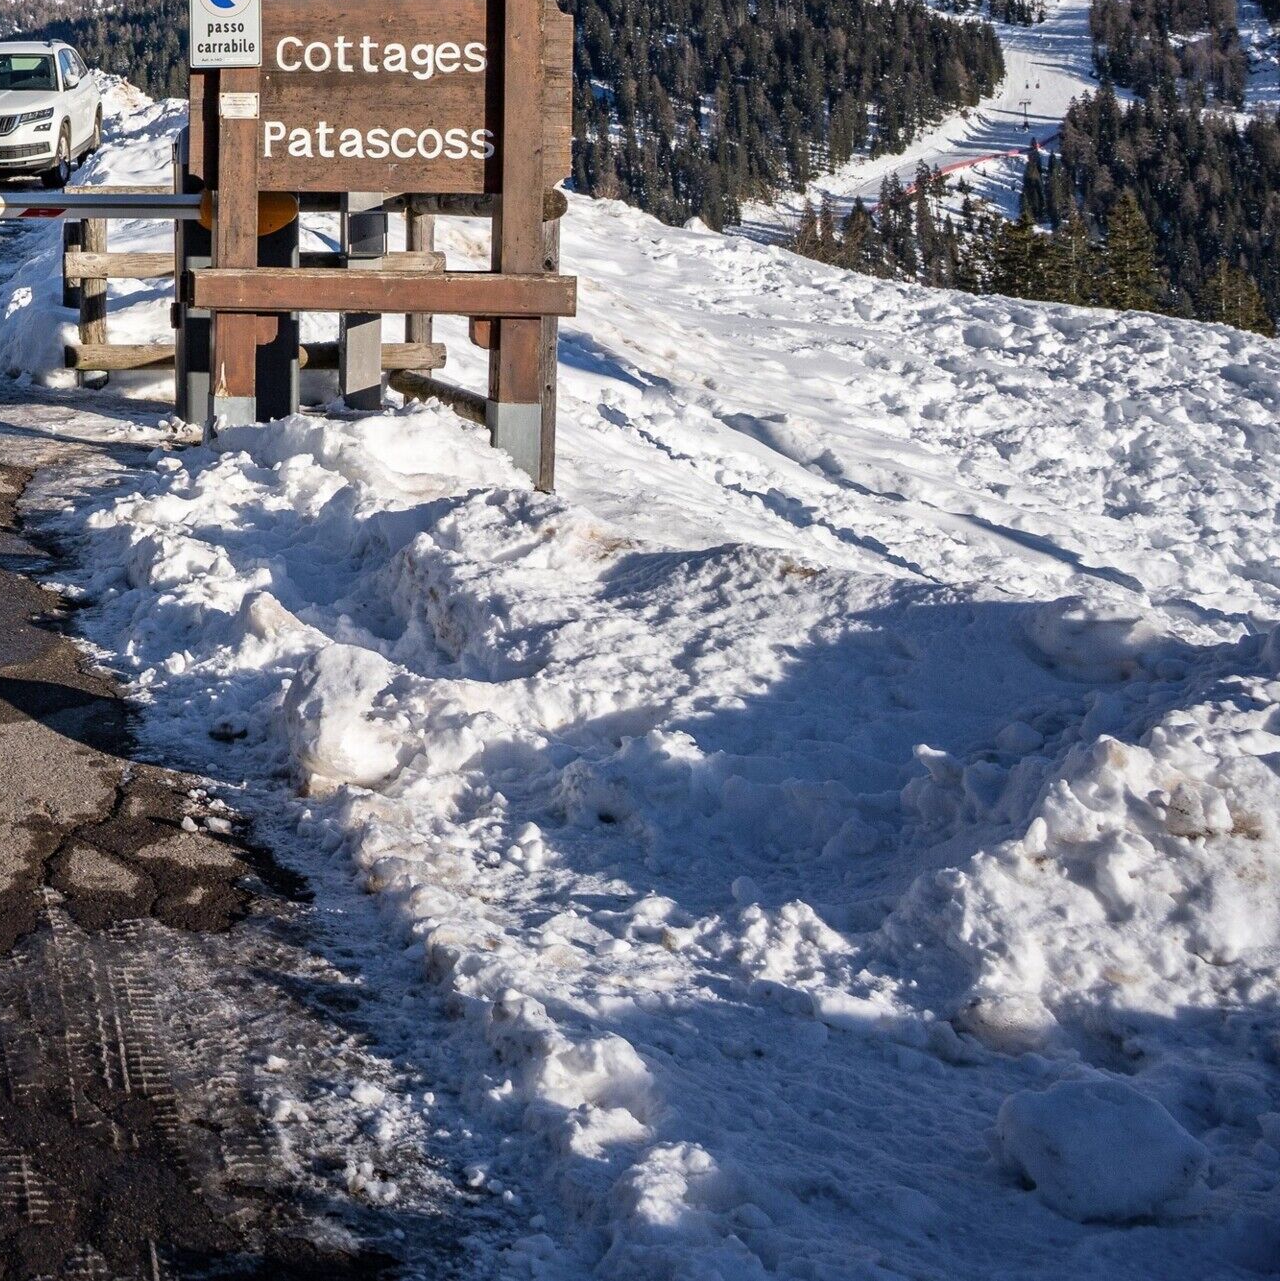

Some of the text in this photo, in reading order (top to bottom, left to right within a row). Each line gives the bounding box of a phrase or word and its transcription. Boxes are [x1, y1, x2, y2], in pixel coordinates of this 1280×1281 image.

[207, 22, 245, 37] passo
[197, 38, 255, 53] carrabile
[276, 35, 488, 80] Cottages
[263, 121, 495, 159] Patascoss
